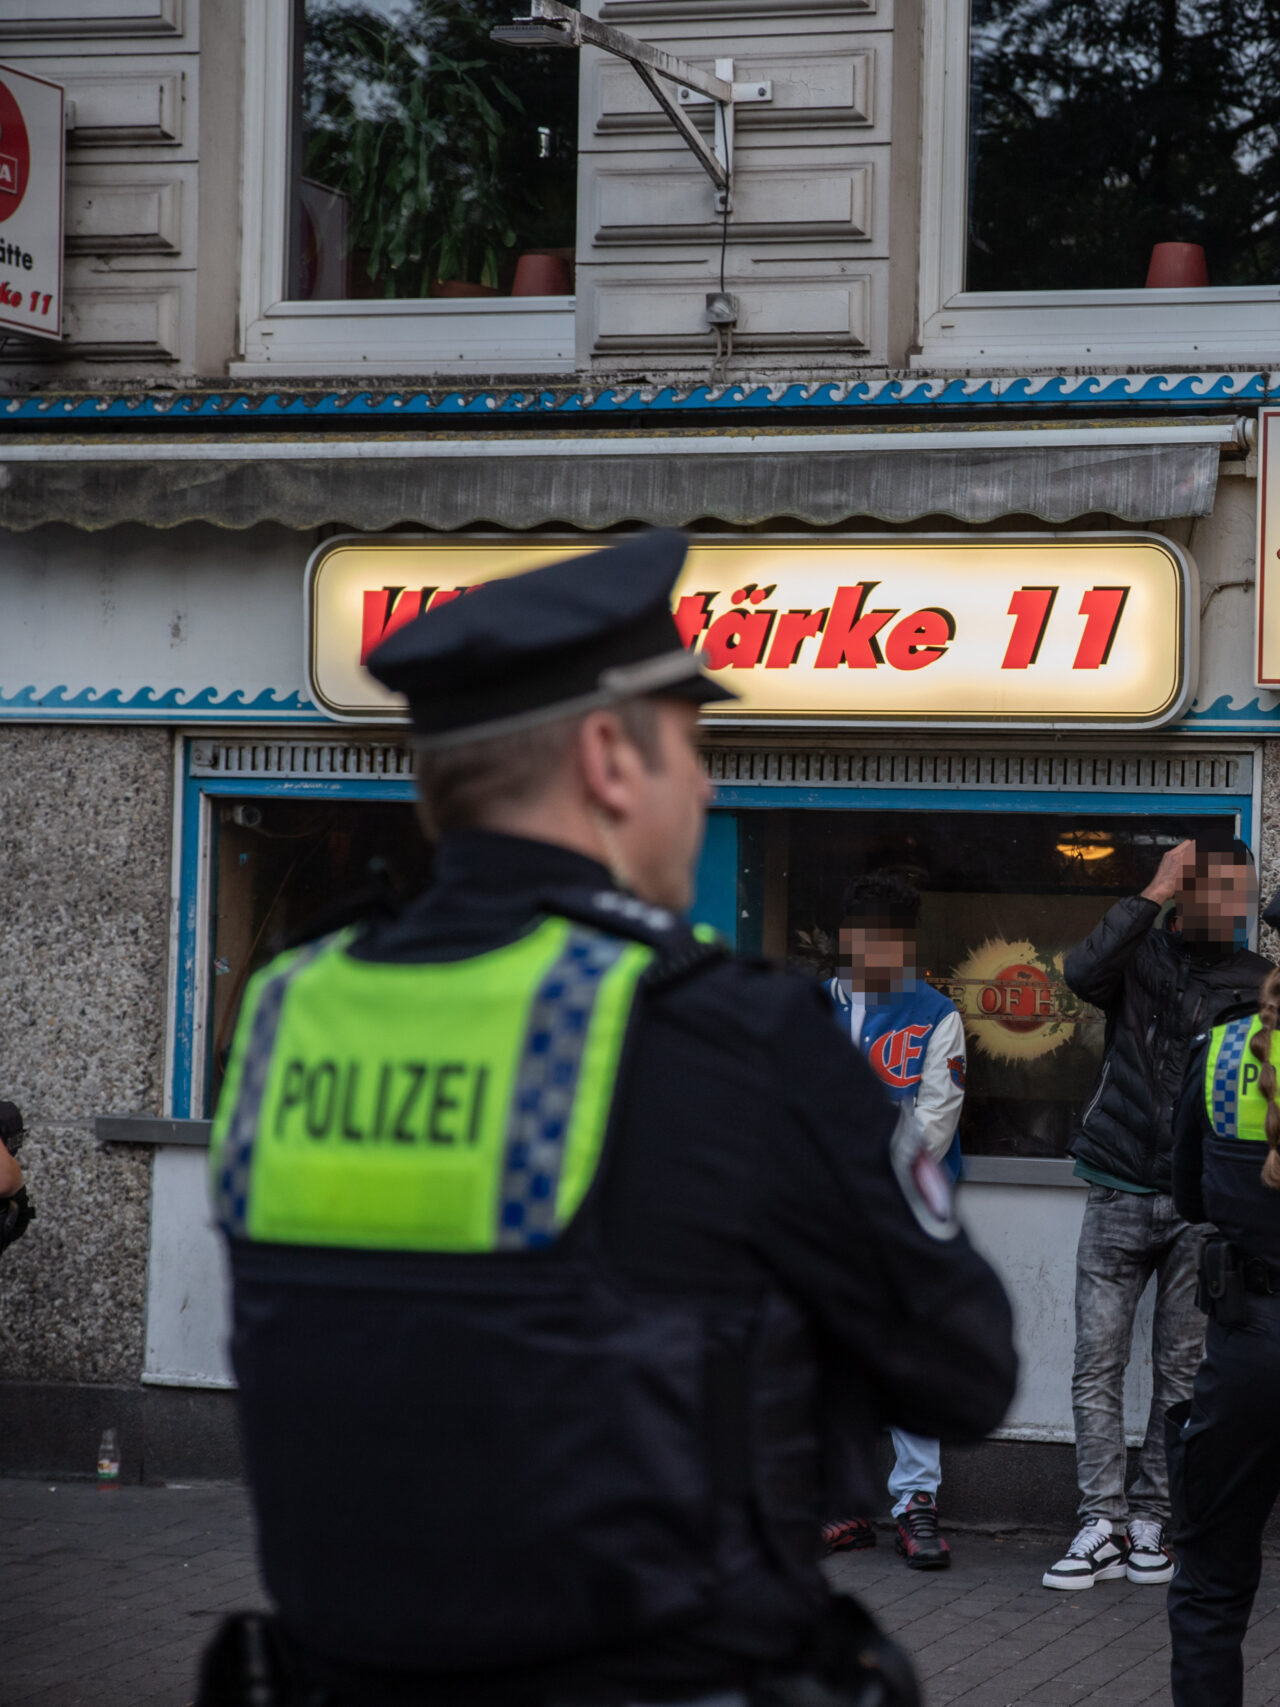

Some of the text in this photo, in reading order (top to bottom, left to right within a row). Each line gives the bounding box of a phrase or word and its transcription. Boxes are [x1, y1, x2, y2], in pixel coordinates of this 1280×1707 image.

[29, 290, 54, 316] 11
[1000, 585, 1132, 670] 11
[976, 985, 1023, 1016] OF
[274, 1057, 489, 1146] POLIZEI
